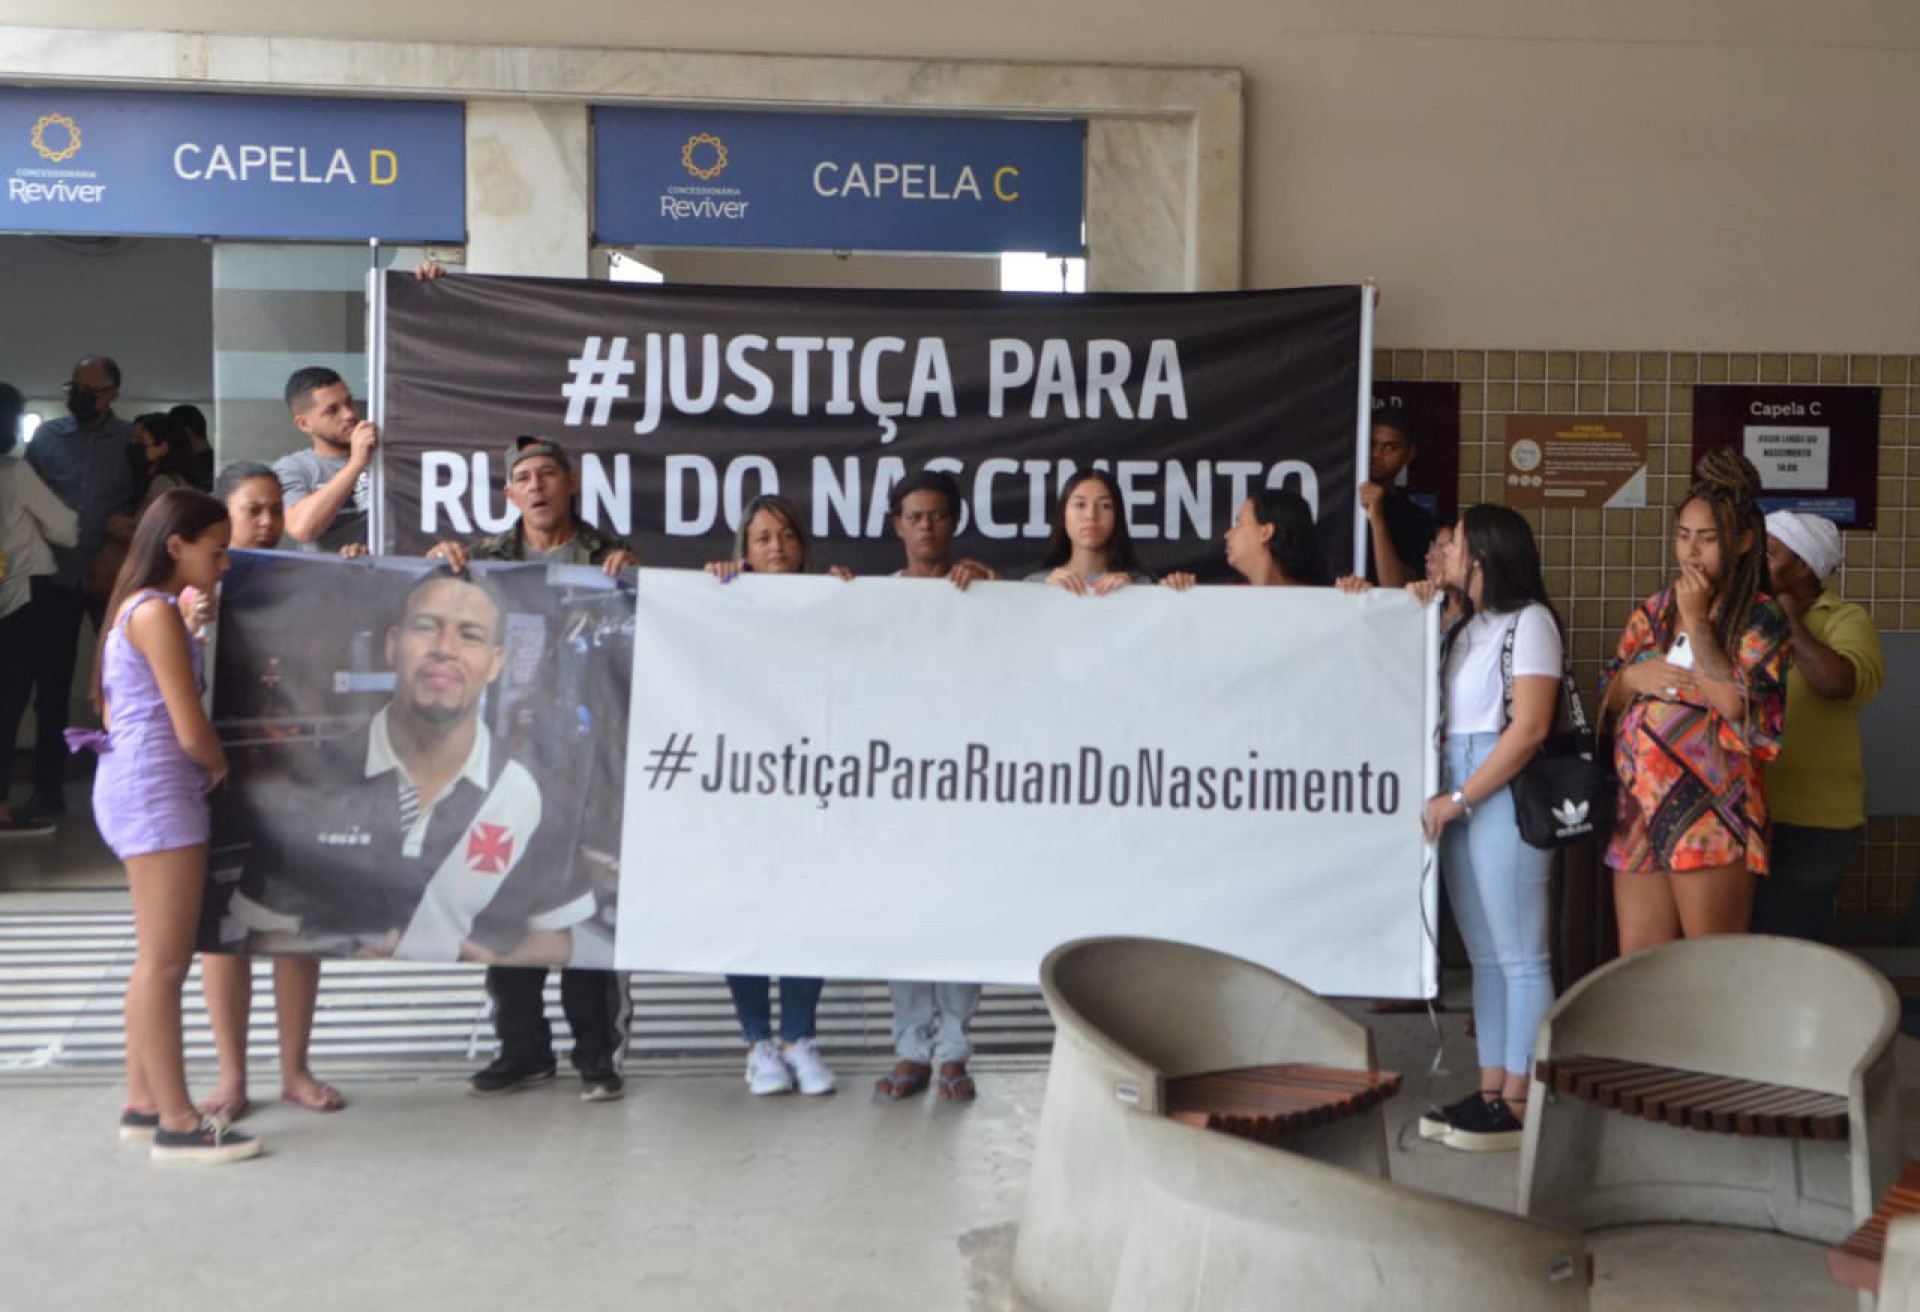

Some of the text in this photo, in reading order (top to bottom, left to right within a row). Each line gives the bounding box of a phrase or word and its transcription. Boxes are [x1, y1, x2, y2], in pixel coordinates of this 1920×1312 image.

[173, 142, 398, 185] CAPELA D
[812, 161, 1020, 202] CAPELA C
[8, 177, 107, 204] Reviver
[660, 195, 750, 221] Reviver
[561, 332, 1189, 444] #JUSTIÇA PARA
[1750, 401, 1822, 418] Capela C
[420, 450, 633, 537] RUN
[665, 453, 780, 537] DO
[812, 455, 1319, 541] NACIENTO
[642, 731, 1401, 815] #JustiçaParaRuanDoNascimento
